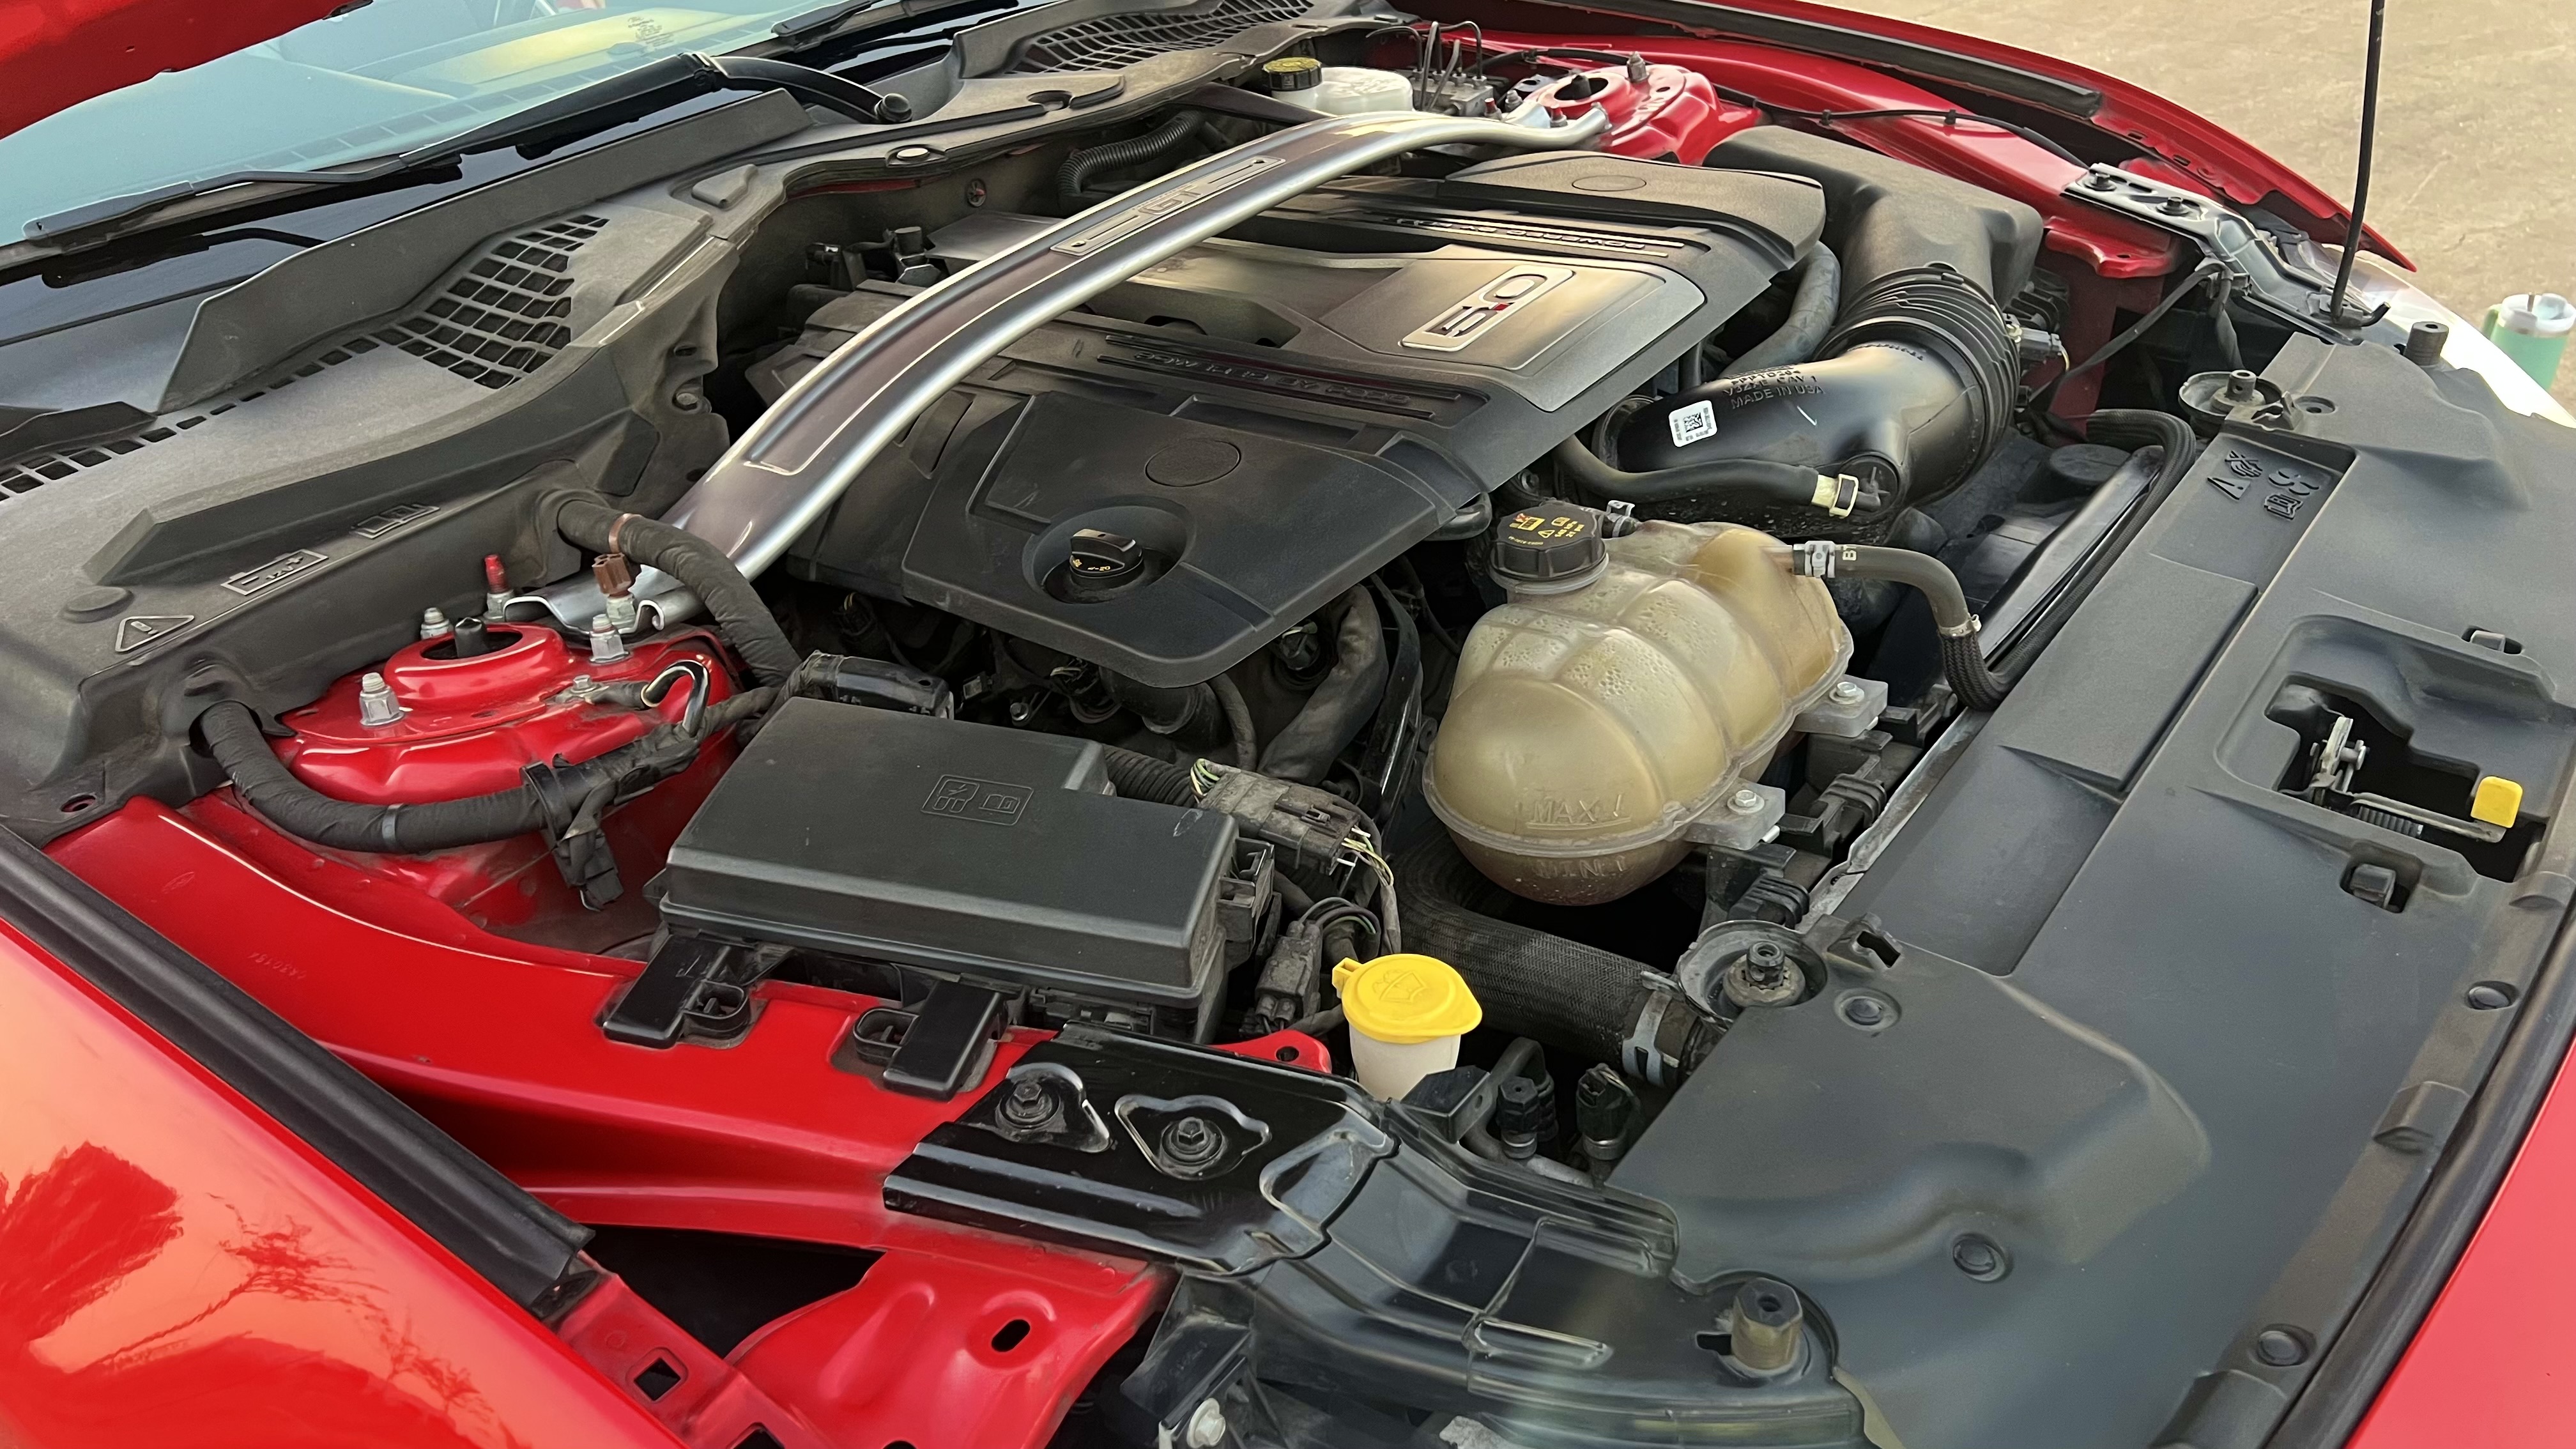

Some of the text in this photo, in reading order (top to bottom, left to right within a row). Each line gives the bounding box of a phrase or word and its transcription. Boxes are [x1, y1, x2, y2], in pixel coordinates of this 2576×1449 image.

[1138, 184, 1202, 215] GT
[1506, 229, 1646, 250] POWERED
[1424, 273, 1548, 338] 5.0
[1325, 385, 1411, 404] FORD
[1730, 384, 1827, 410] MADE IN USA
[1530, 799, 1599, 824] MAX
[1536, 859, 1606, 879] MIN
